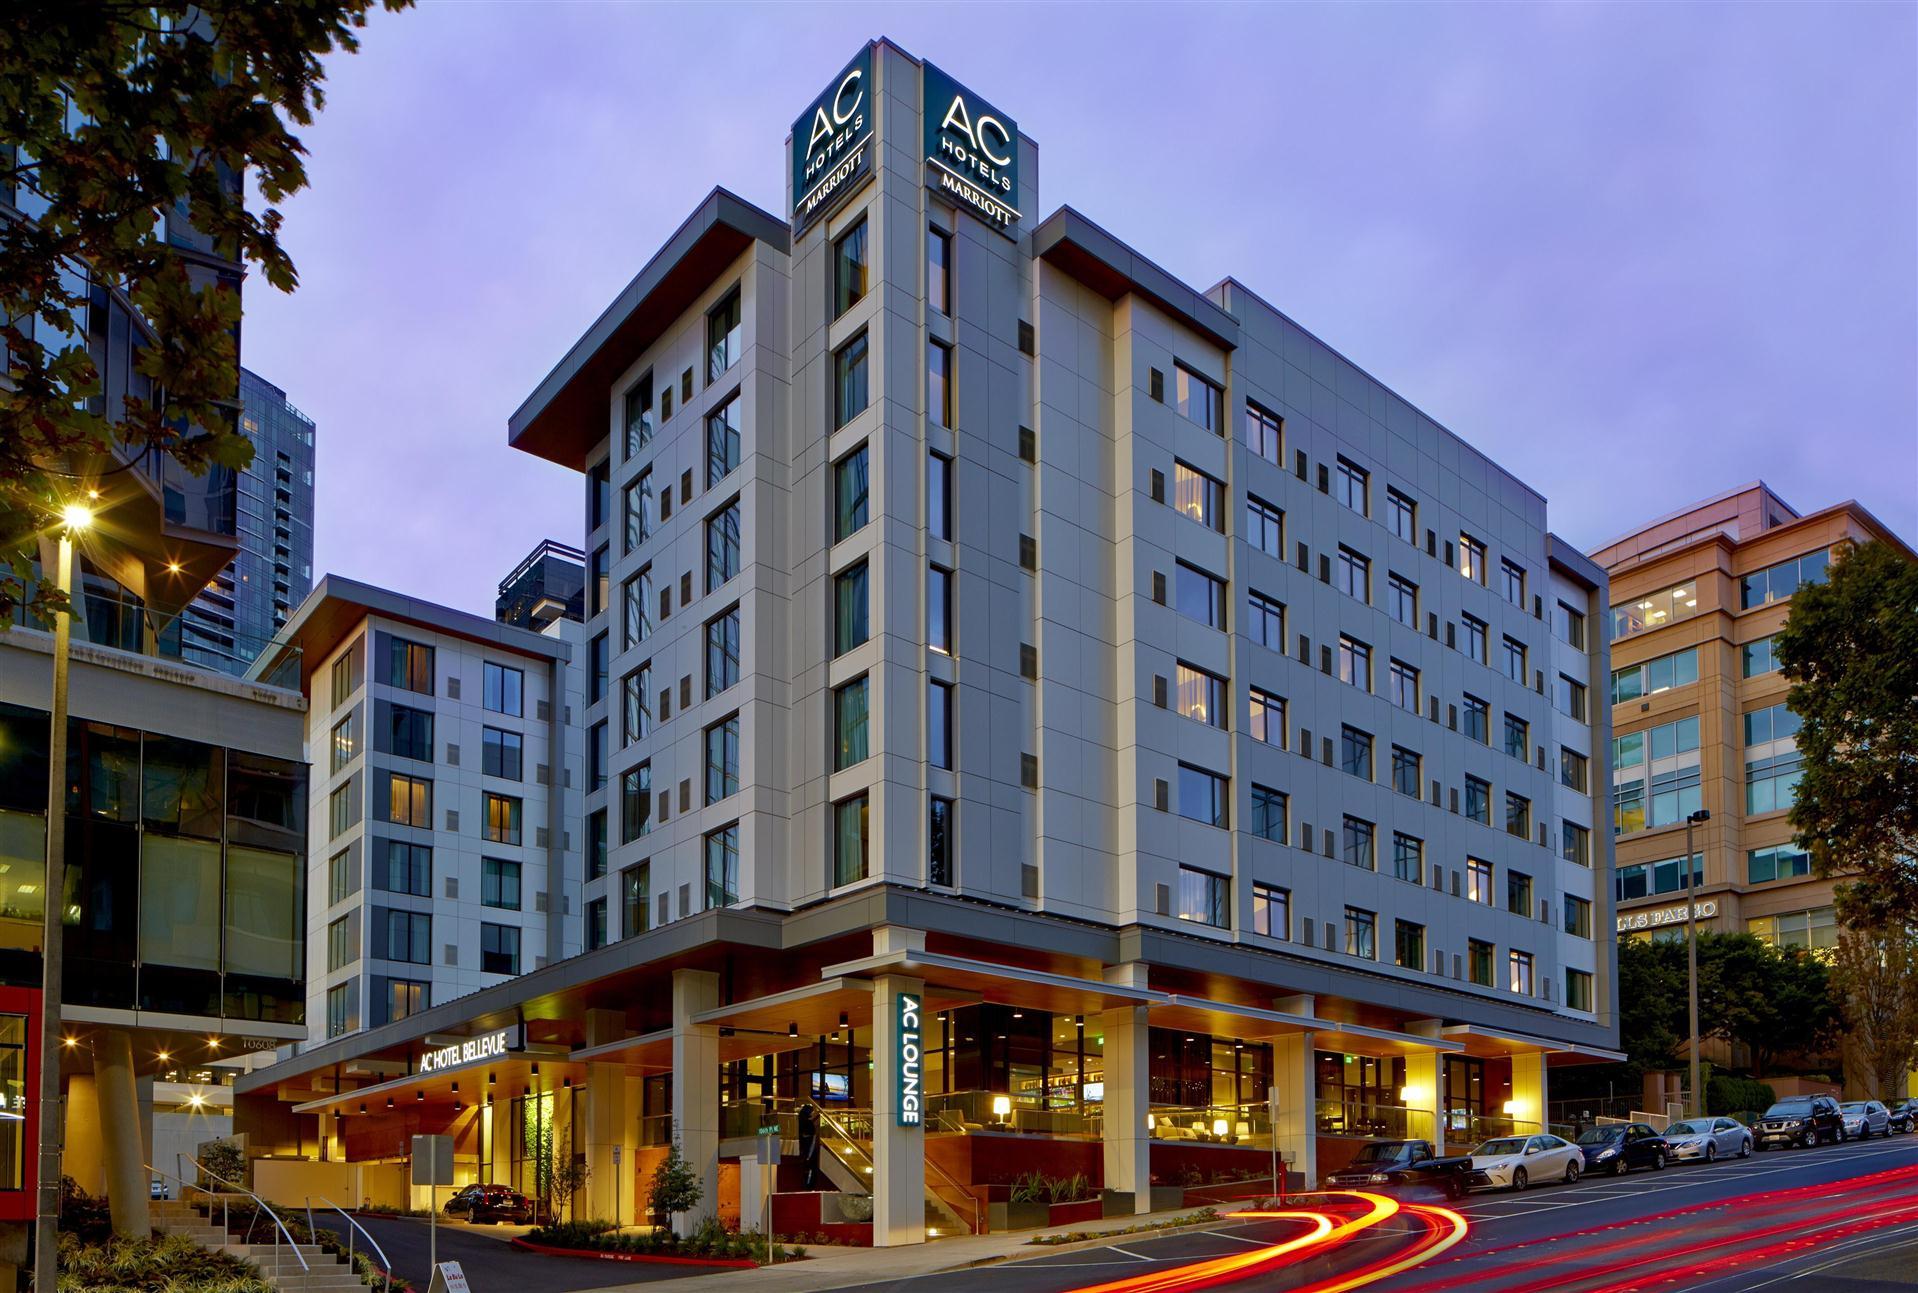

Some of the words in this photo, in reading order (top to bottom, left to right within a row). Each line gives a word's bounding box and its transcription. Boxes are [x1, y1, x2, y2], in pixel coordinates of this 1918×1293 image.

[806, 70, 863, 161] AC
[942, 95, 1011, 167] AC
[806, 114, 863, 179] HOTELS
[942, 136, 1011, 191] HOTELS
[806, 147, 864, 215] MARRIOTT
[942, 172, 1011, 226] MARRIOTT
[902, 996, 919, 1029] AC
[242, 1038, 276, 1050] 10608
[420, 1053, 433, 1073] AC
[433, 1045, 462, 1069] HOTEL
[462, 1032, 506, 1062] BELLEVUE
[902, 1033, 919, 1123] LOUNGE
